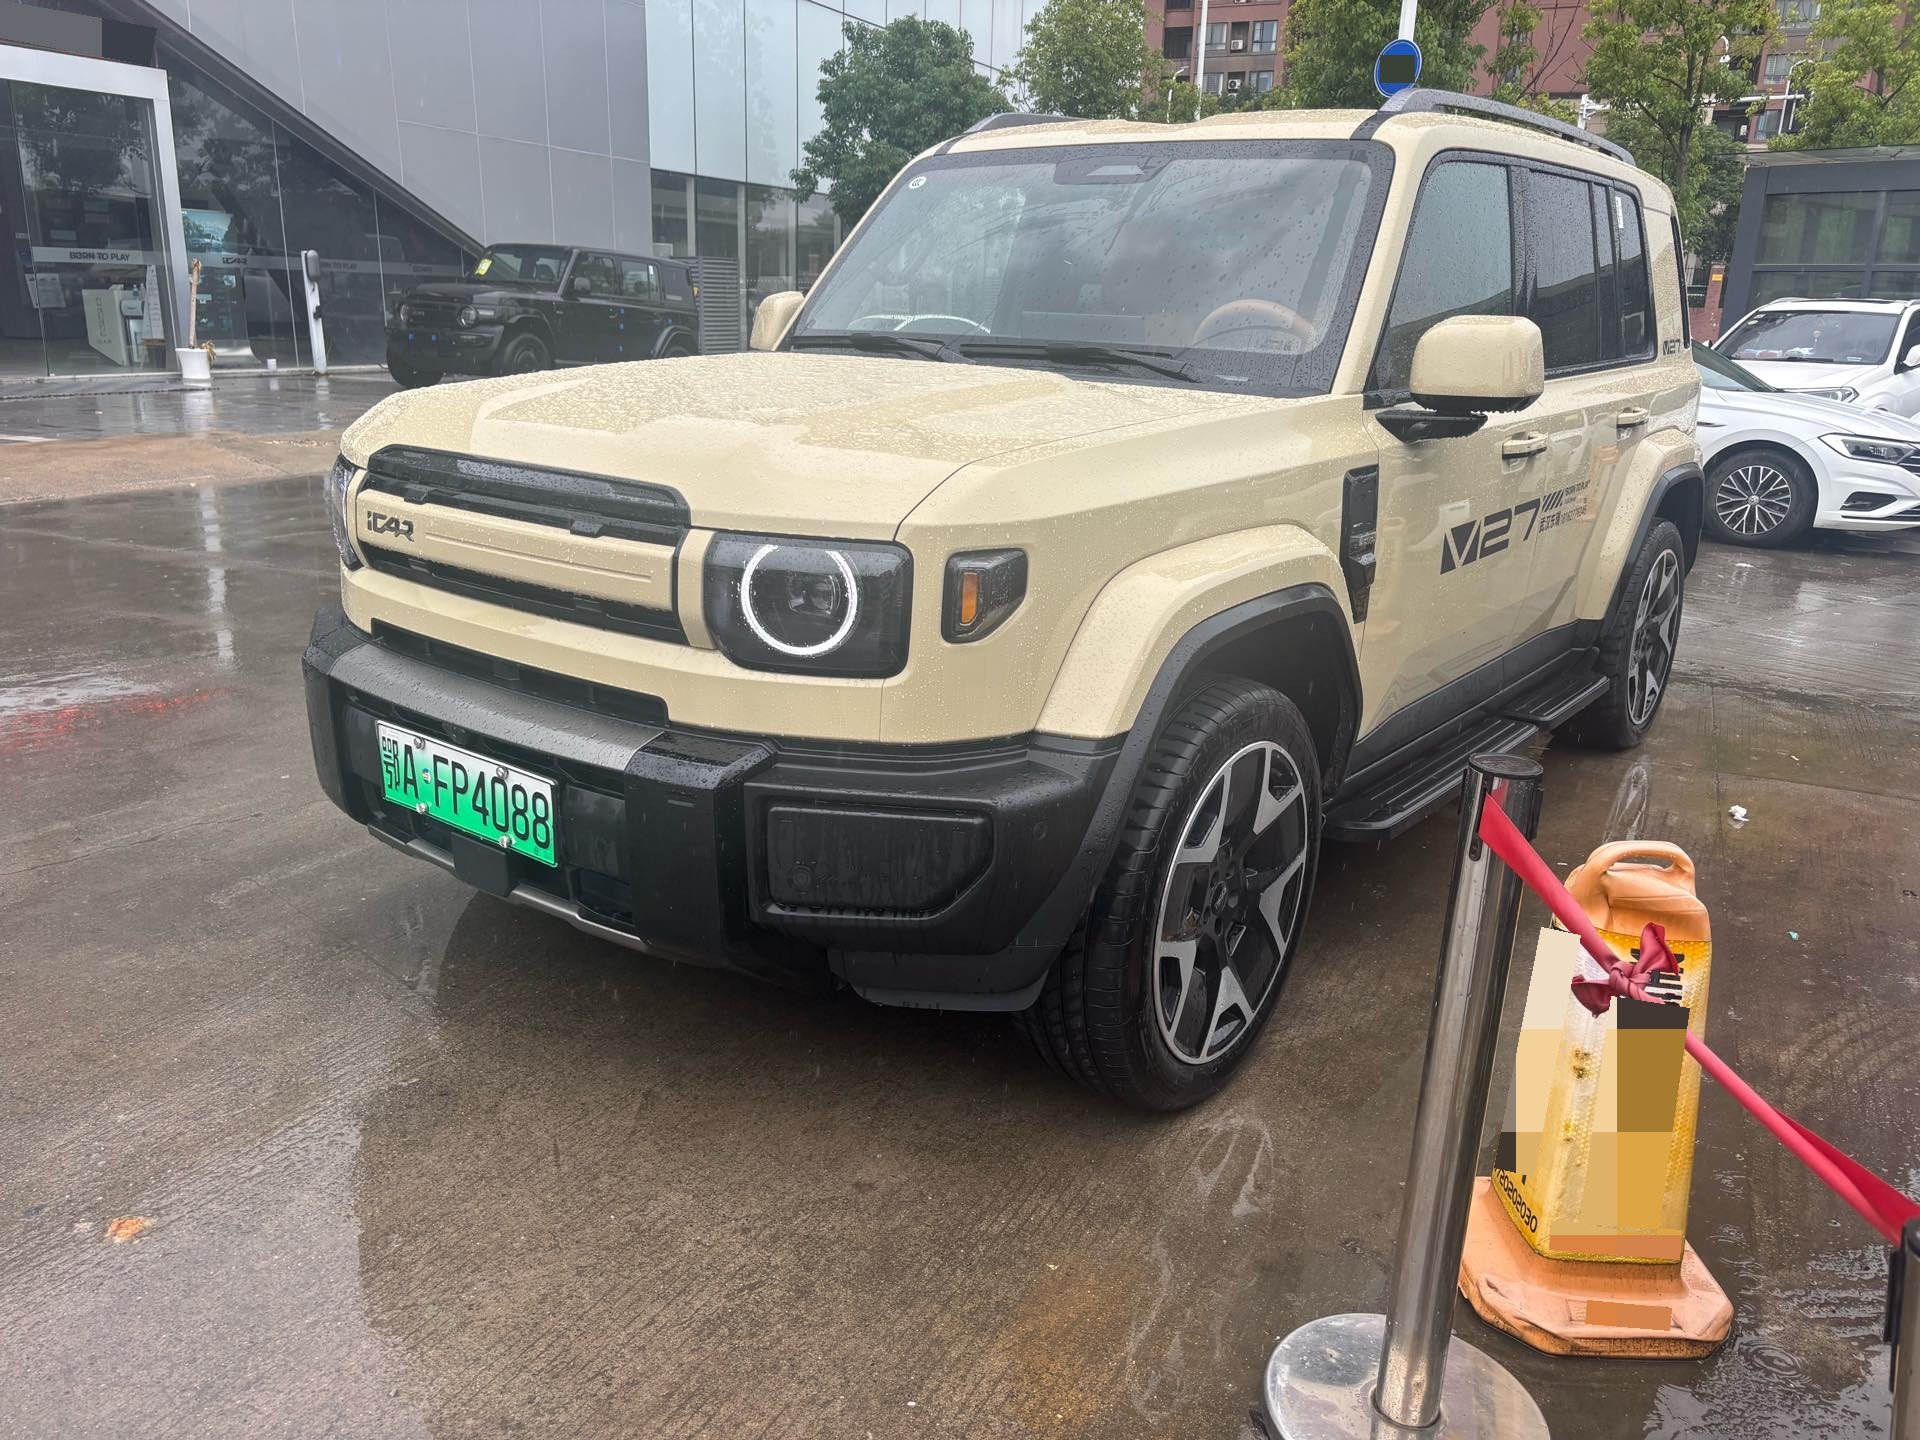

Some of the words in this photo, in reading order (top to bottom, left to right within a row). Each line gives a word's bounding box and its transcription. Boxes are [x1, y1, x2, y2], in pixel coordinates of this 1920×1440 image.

[70, 251, 95, 260] BORN
[96, 252, 109, 260] TO
[110, 253, 130, 261] PLAY
